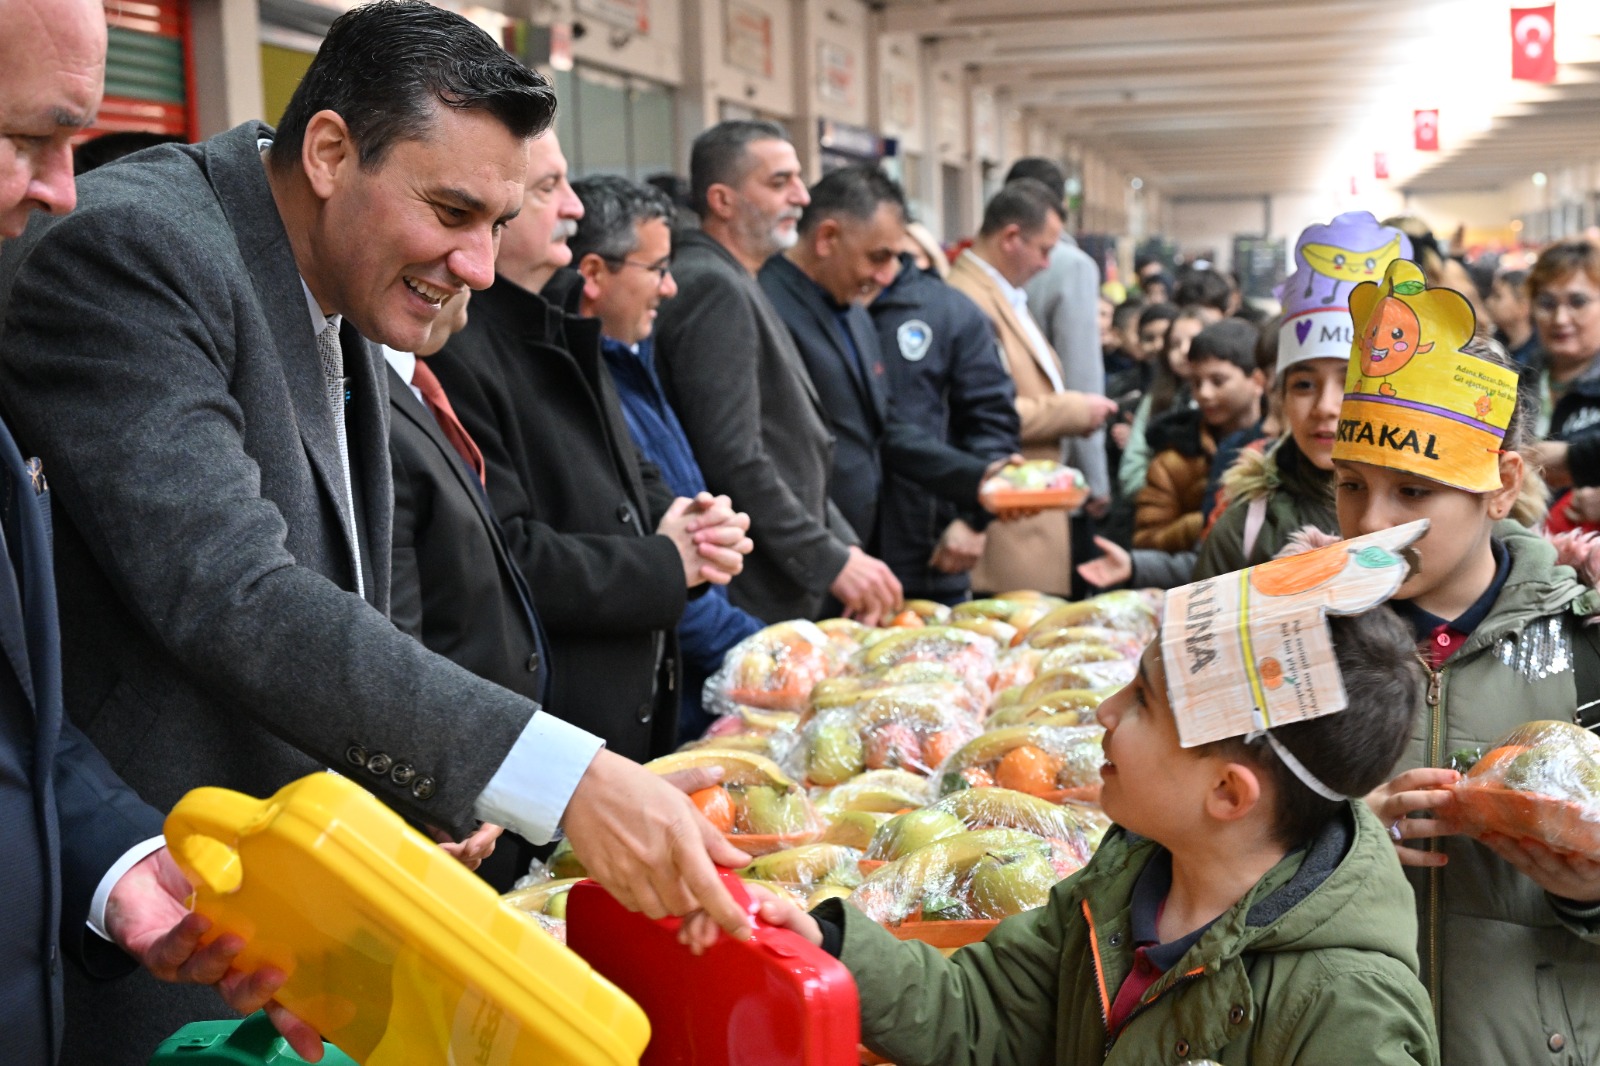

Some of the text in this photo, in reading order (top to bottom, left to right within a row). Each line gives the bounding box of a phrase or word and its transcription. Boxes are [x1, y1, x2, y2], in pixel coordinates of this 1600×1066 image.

[1319, 326, 1353, 344] MU
[1453, 374, 1464, 383] Git
[1337, 419, 1440, 460] RTAKAL
[1185, 579, 1221, 675] ALİNA
[1283, 639, 1293, 655] bol
